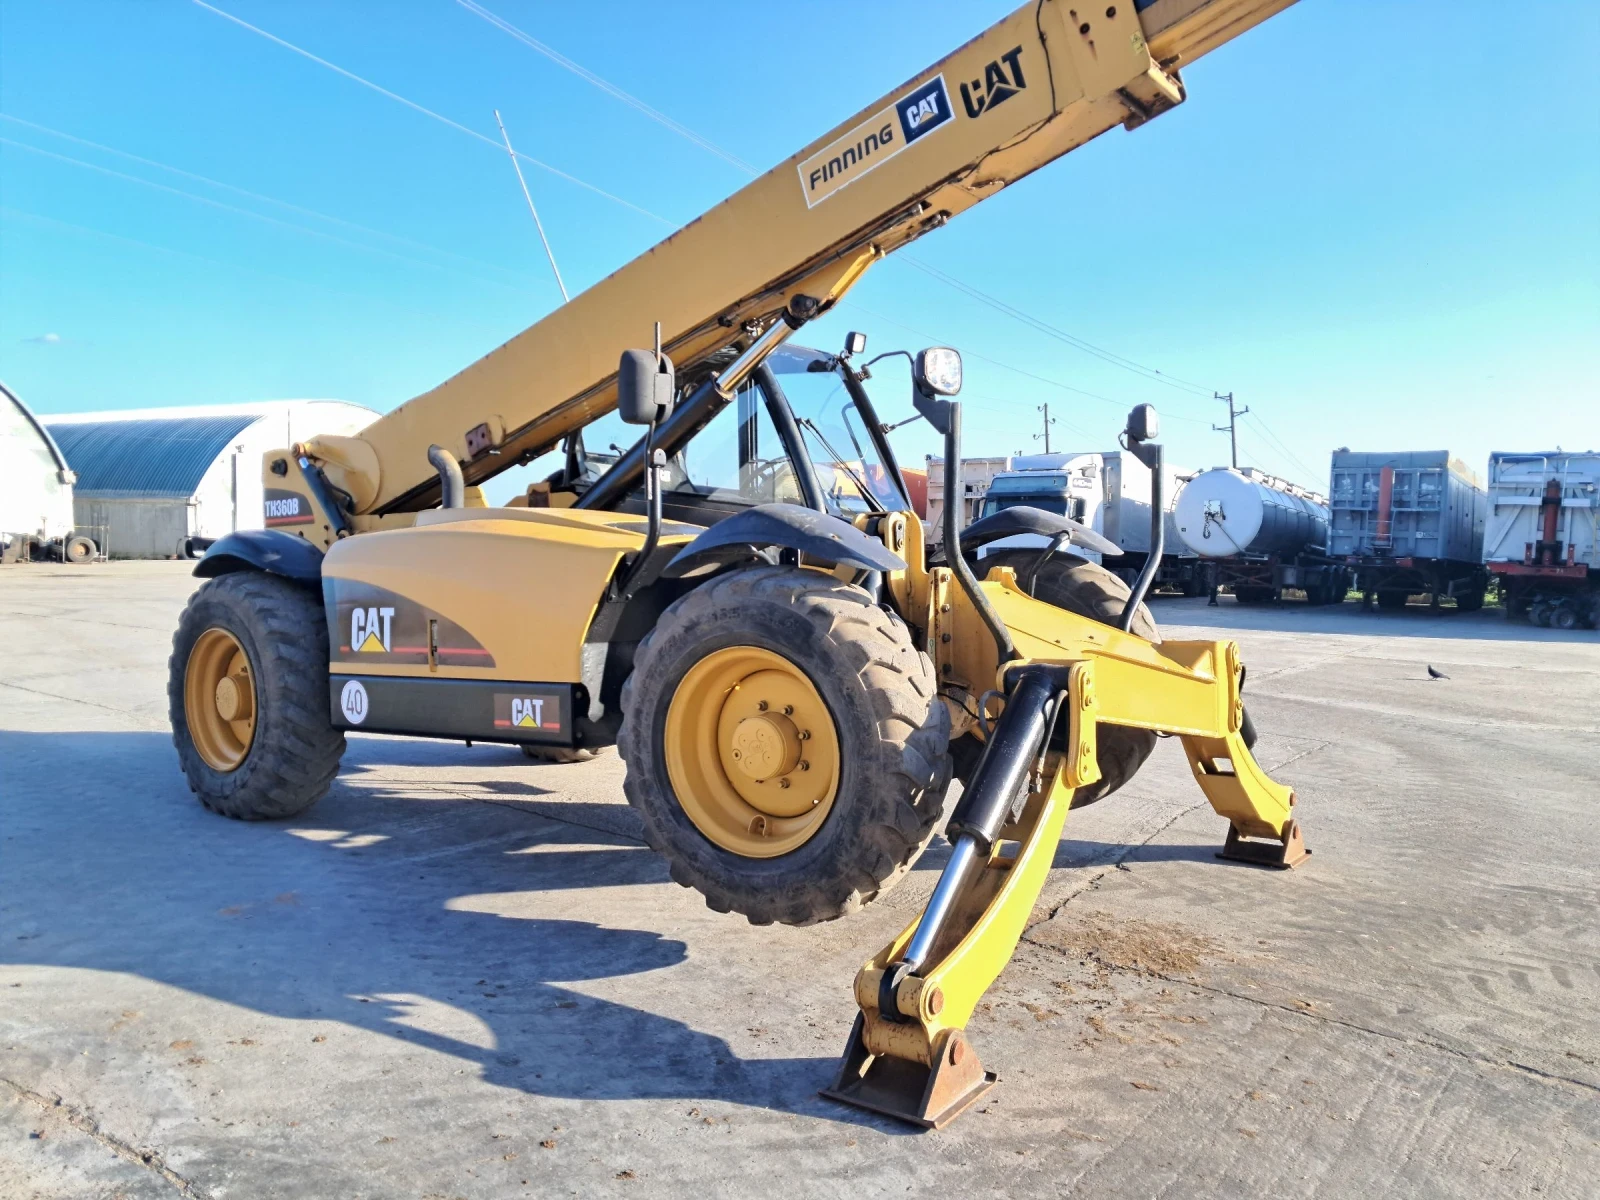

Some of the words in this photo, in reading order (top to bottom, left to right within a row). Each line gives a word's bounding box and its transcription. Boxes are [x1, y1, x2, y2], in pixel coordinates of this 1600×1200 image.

[960, 45, 1027, 119] CAT
[810, 123, 893, 190] FINNING
[906, 91, 939, 129] CAT
[265, 497, 299, 517] TH360B
[351, 607, 395, 653] CAT
[346, 689, 363, 715] 40
[512, 698, 544, 728] CAT
